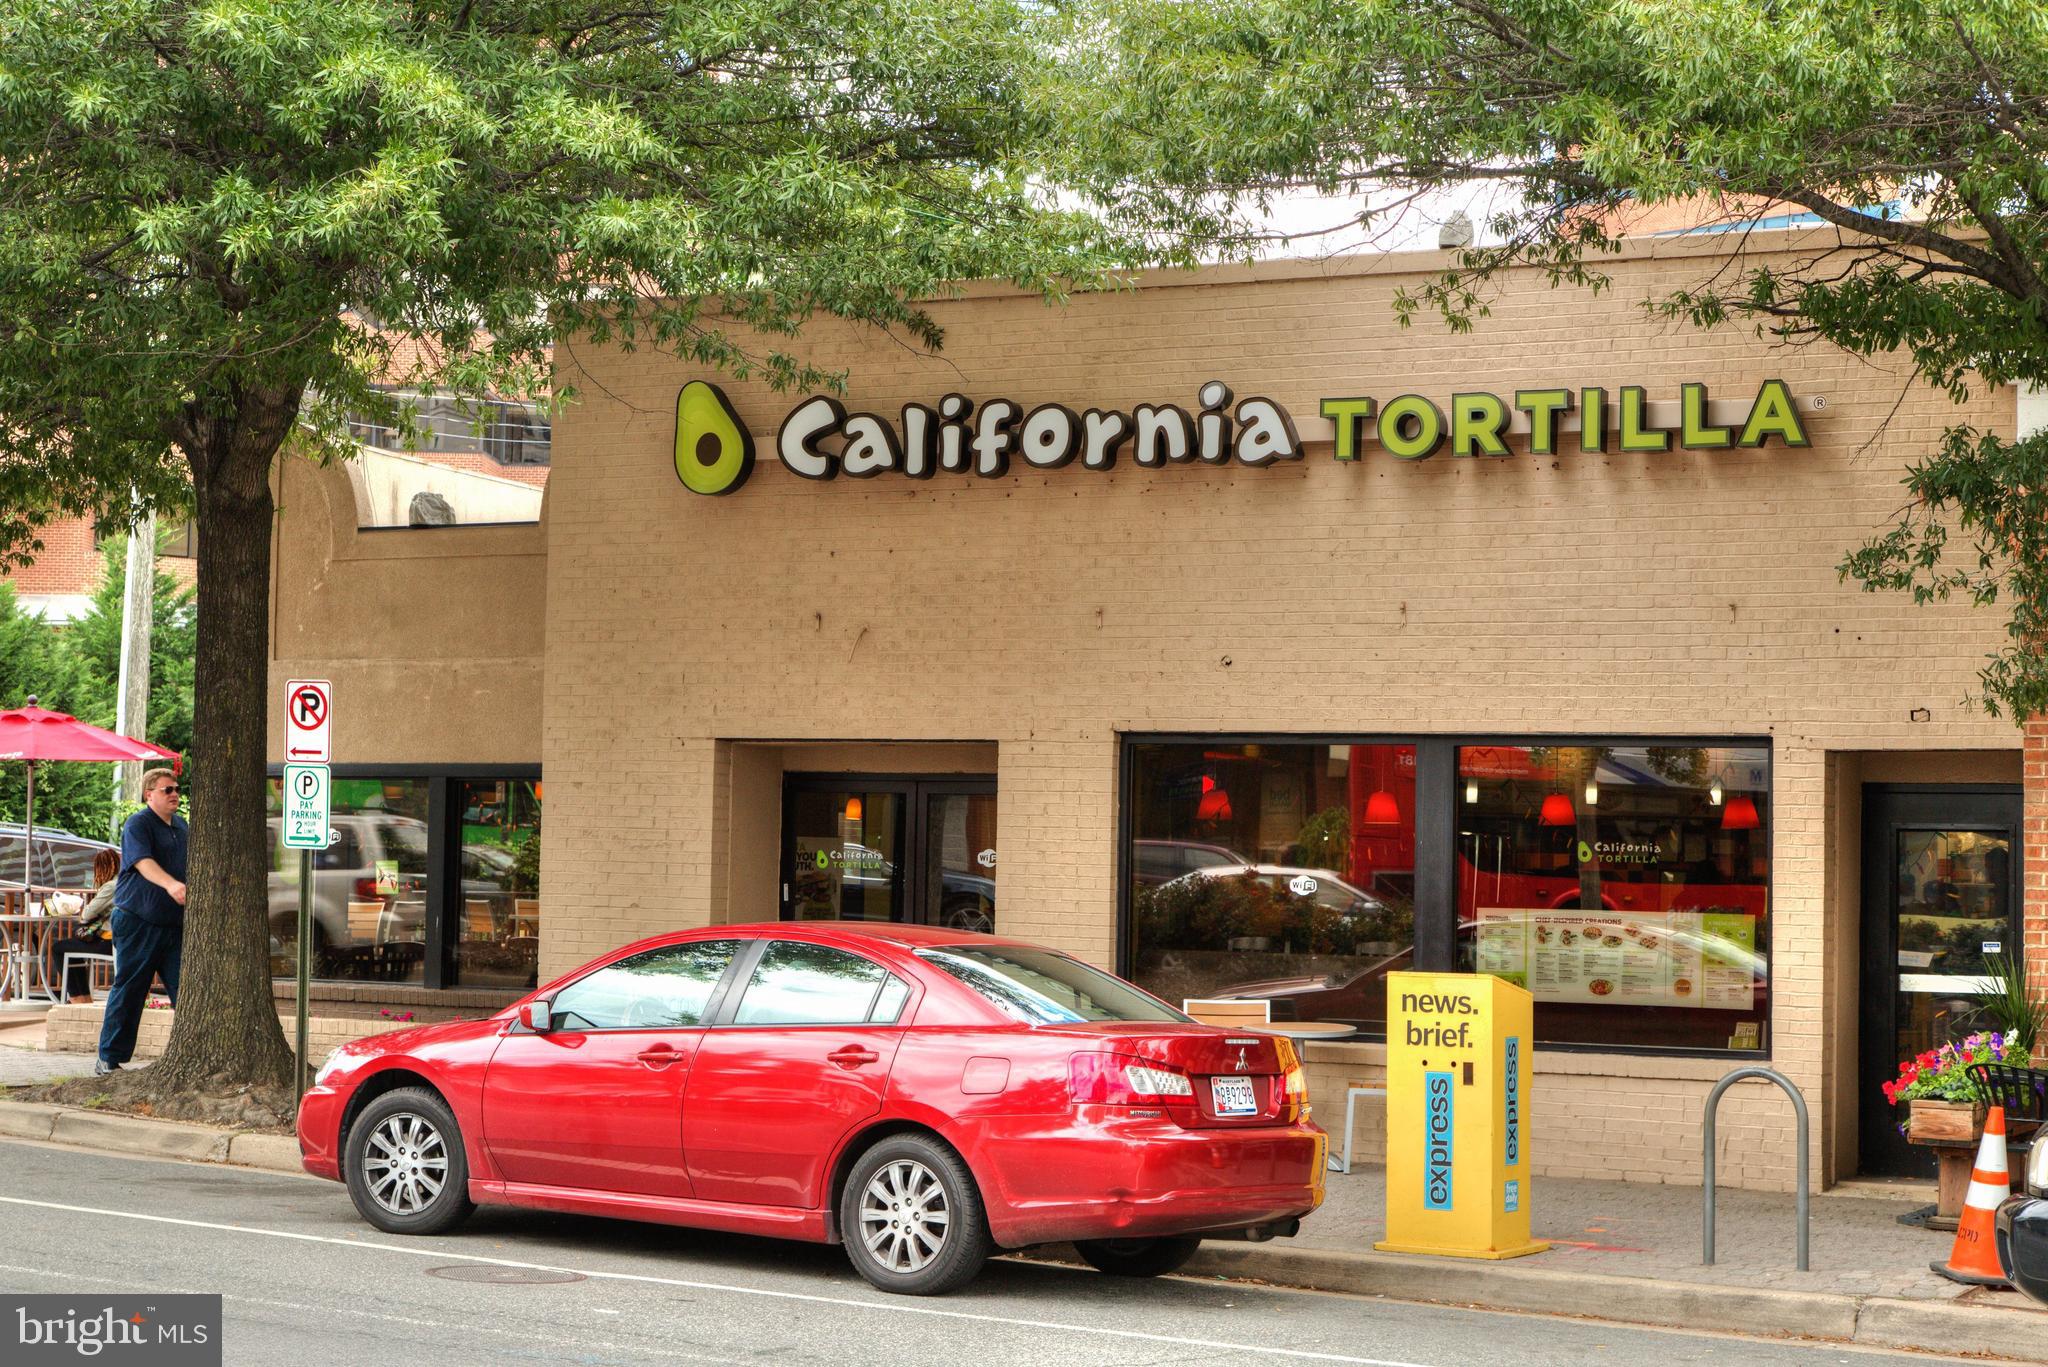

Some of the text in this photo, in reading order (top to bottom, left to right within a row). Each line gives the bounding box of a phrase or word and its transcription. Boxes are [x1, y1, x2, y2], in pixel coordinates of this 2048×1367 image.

[777, 381, 1302, 480] California
[1320, 379, 1812, 461] TORTILLA
[303, 776, 312, 795] P
[300, 801, 313, 809] PAY
[291, 810, 322, 820] PARKING
[296, 821, 302, 834] 2
[830, 850, 883, 860] California
[1594, 842, 1661, 853] California
[1598, 855, 1657, 863] TORTILLA
[1402, 993, 1479, 1015] news.
[1406, 1020, 1473, 1049] brief.
[1507, 1042, 1518, 1160] express
[1430, 1078, 1453, 1205] express
